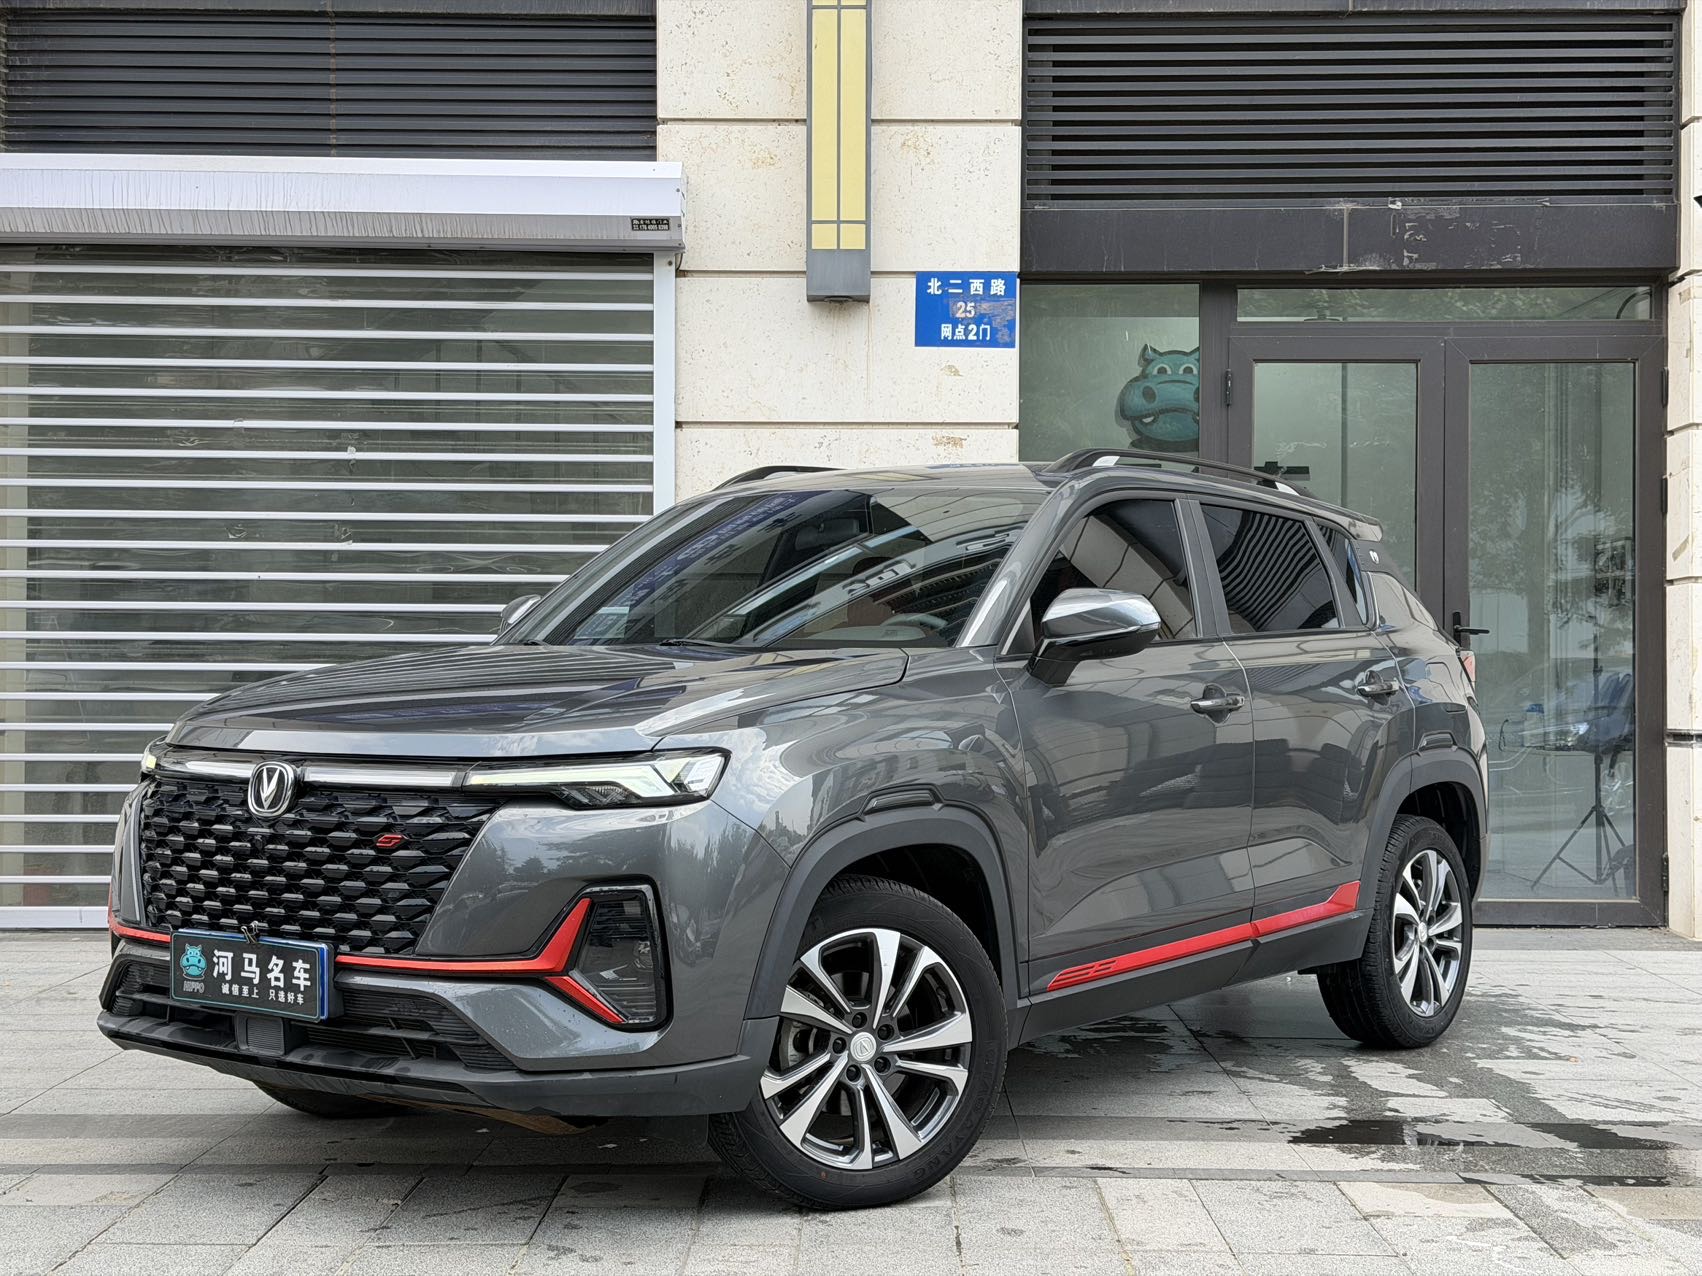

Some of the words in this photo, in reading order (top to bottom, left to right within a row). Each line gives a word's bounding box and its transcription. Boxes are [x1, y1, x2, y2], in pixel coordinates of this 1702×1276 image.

[927, 278, 1006, 296] 北二西路
[955, 301, 976, 318] 25
[941, 323, 991, 341] 网点2门
[212, 949, 311, 992] 河马名车
[221, 982, 259, 999] 诚信至上
[268, 990, 305, 1006] 只选好车
